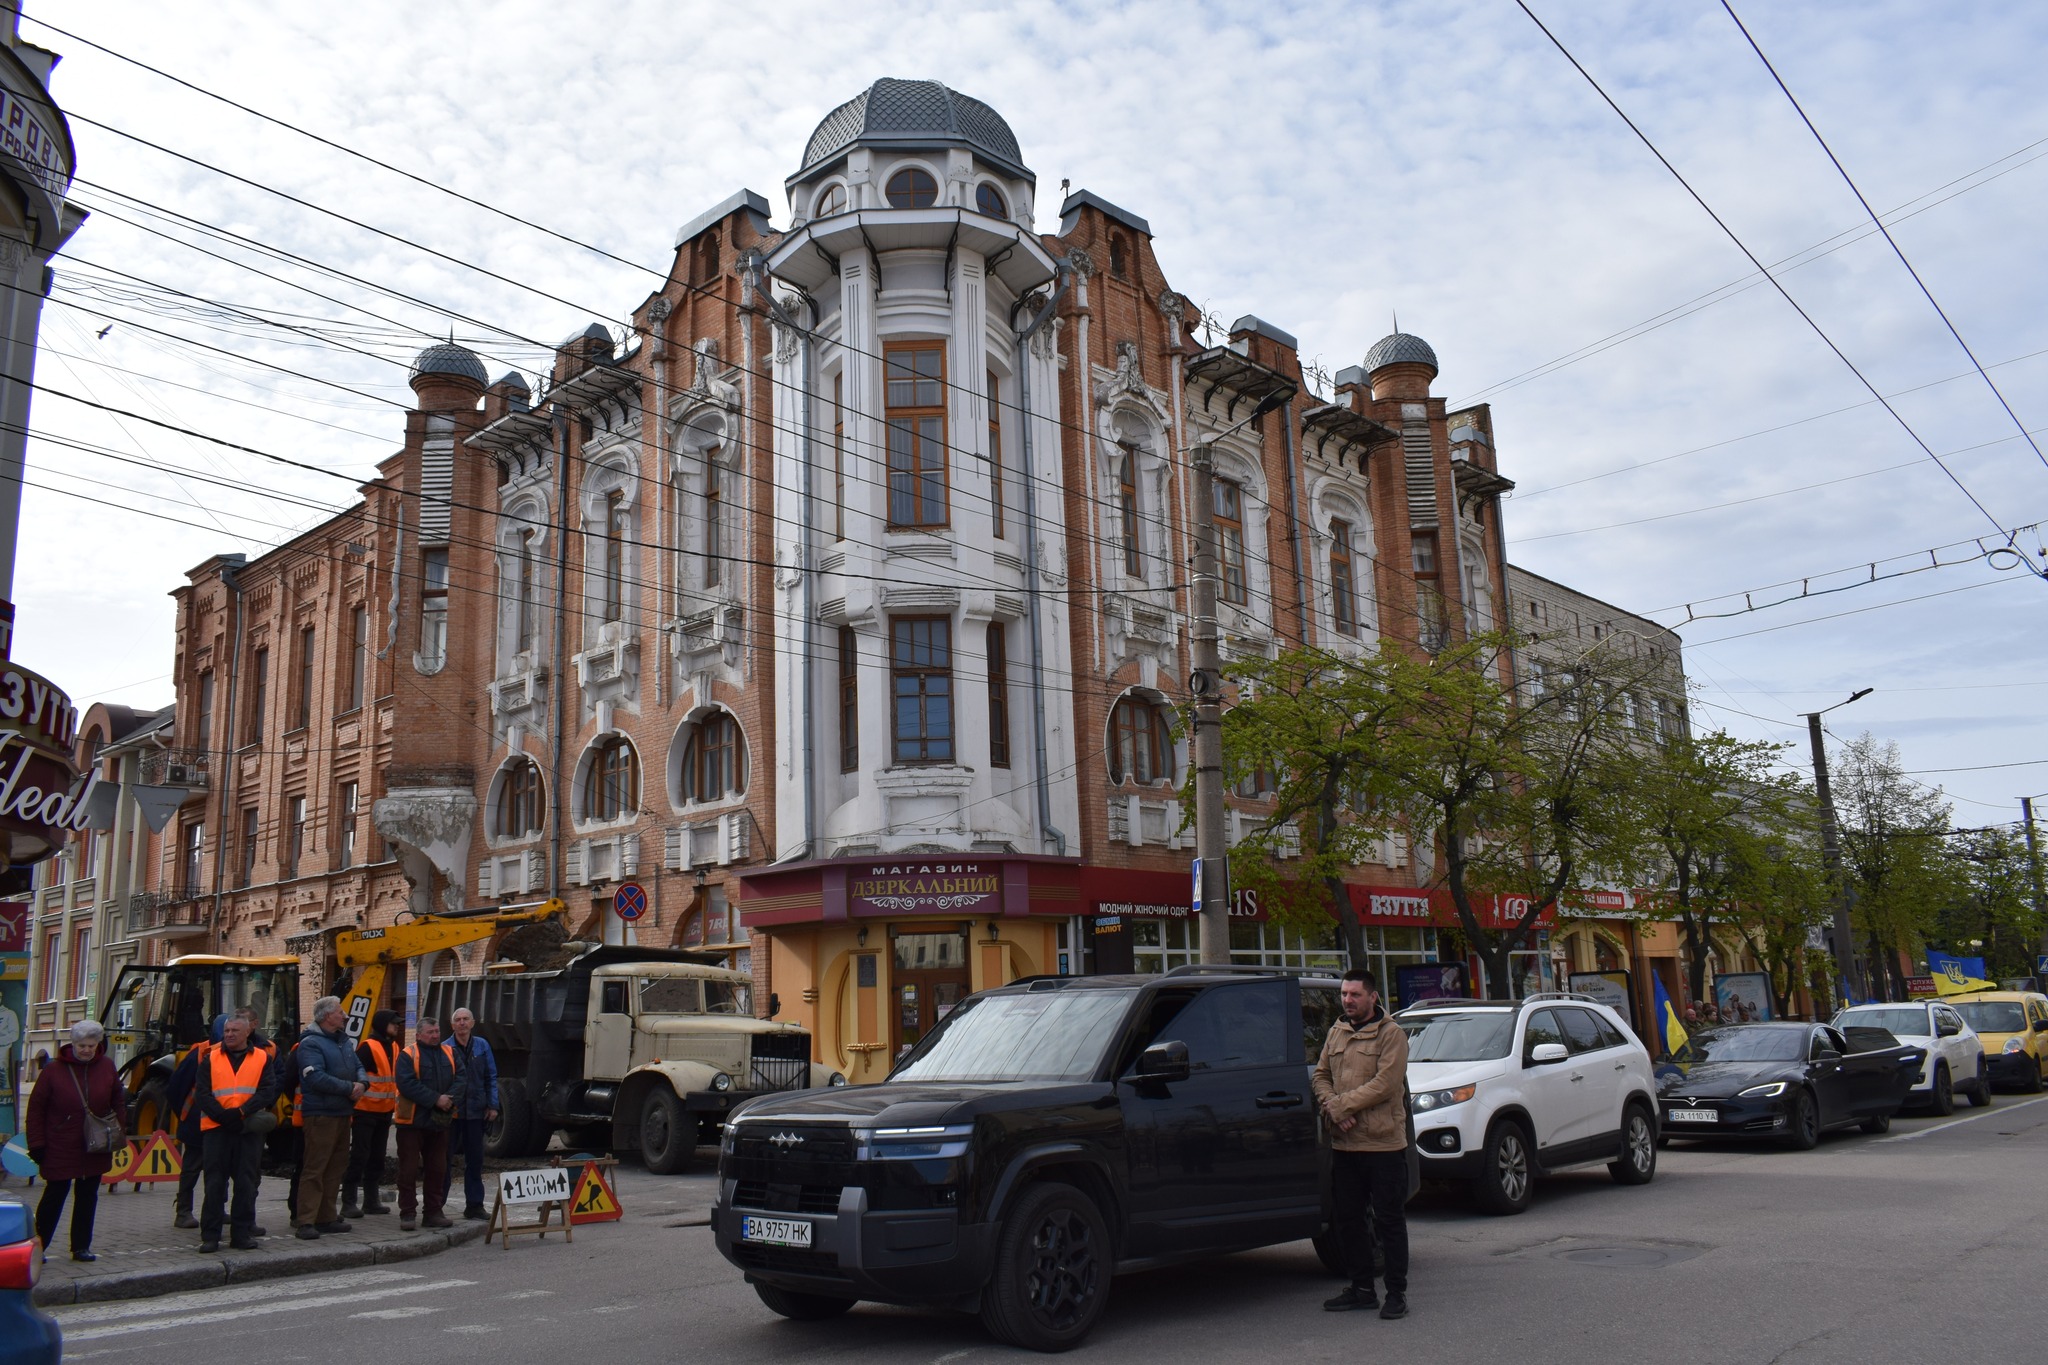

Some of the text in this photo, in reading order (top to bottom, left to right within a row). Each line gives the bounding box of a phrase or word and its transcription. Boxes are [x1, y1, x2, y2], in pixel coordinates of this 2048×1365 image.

[872, 865, 978, 875] МАГАЗИН
[852, 875, 998, 898] ДЗЕРКАЛЬНИЙ
[1099, 902, 1189, 917] МОДНИЙ ЖІНОЧИЙ ОДЯГ
[1370, 895, 1429, 917] ВЗУТТЯ
[1096, 916, 1121, 926] ОБМІН
[1095, 925, 1122, 934] ВАЛЮТ
[1674, 1112, 1685, 1120] BA
[1687, 1112, 1704, 1120] 1110
[749, 1220, 809, 1241] BA 9757 HK
